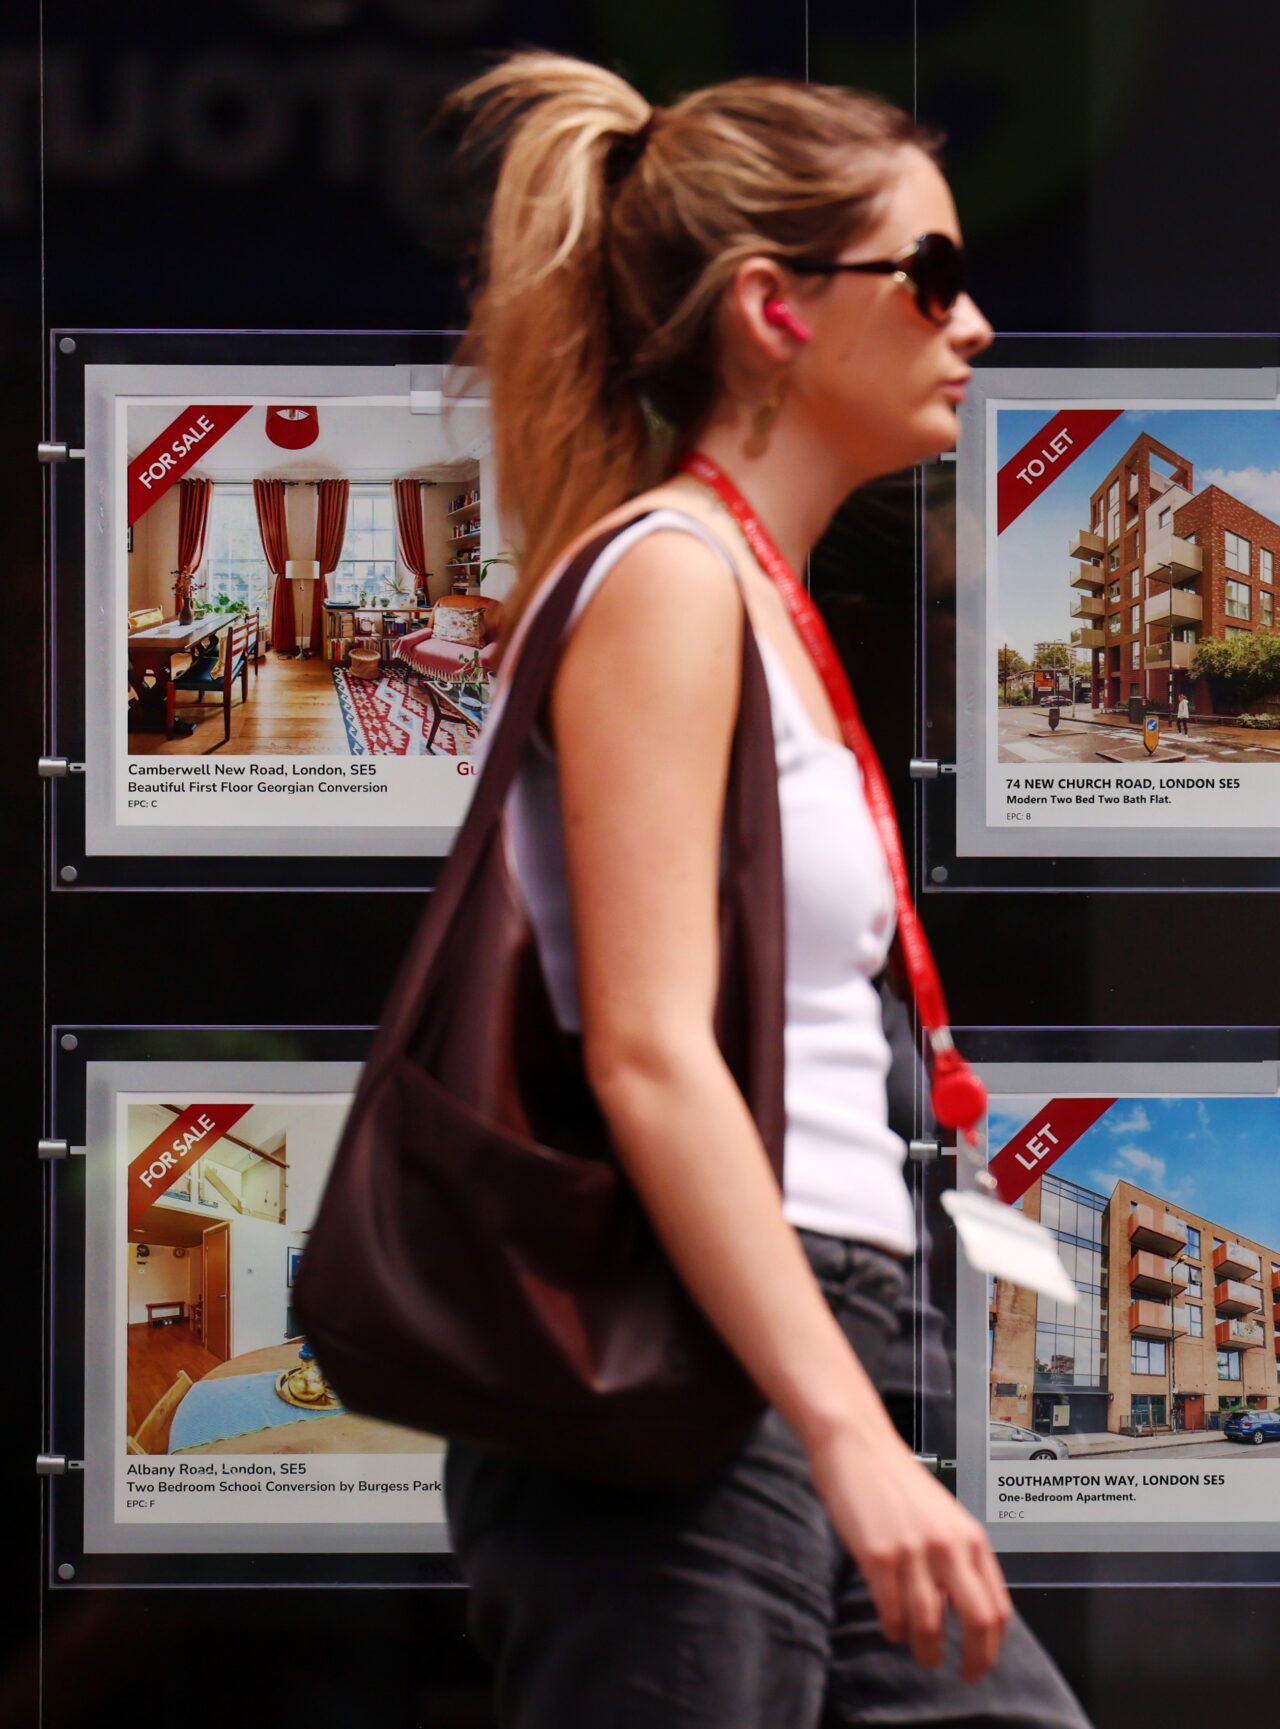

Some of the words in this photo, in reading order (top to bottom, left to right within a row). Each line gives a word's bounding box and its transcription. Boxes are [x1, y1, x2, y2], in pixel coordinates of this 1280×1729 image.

[138, 452, 178, 489] FOR
[172, 414, 216, 458] SALE
[1015, 458, 1046, 485] TO
[1041, 428, 1074, 463] LET
[128, 763, 211, 776] Camberwell
[214, 763, 246, 776] New
[249, 763, 288, 777] Road,
[292, 763, 346, 777] London,
[350, 763, 377, 776] SE5
[128, 781, 186, 793] Beautiful
[189, 781, 218, 793] First
[220, 781, 254, 793] Floor
[257, 781, 314, 795] Georgian
[317, 781, 388, 793] Conversion
[1005, 778, 1021, 790] 74
[1024, 778, 1055, 790] NEW
[1057, 778, 1112, 789] CHURCH
[1115, 778, 1155, 791] ROAD,
[1159, 778, 1215, 789] LONDON
[1218, 778, 1241, 789] SE5
[127, 799, 149, 808] EPC:
[150, 799, 158, 808] C
[1006, 794, 1048, 805] Modern
[1049, 794, 1073, 804] Two
[1075, 794, 1095, 804] Bed
[1097, 794, 1120, 804] Two
[1123, 794, 1147, 804] Bath
[1149, 794, 1172, 804] Flat.
[1006, 812, 1024, 821] EPC:
[1025, 812, 1032, 821] B
[138, 1151, 179, 1188] FOR
[172, 1113, 216, 1156] SALE
[1014, 1122, 1059, 1171] LET
[126, 1463, 176, 1478] Albany
[179, 1463, 218, 1476] Road,
[222, 1463, 276, 1476] London,
[280, 1462, 307, 1475] SE5
[126, 1481, 155, 1493] Two
[158, 1481, 216, 1493] Bedroom
[219, 1481, 262, 1492] School
[265, 1480, 336, 1492] Conversion
[339, 1480, 355, 1493] by
[358, 1480, 410, 1494] Burgess
[413, 1480, 442, 1493] Park
[997, 1475, 1101, 1487] SOUTHAMPTON
[1103, 1475, 1138, 1488] WAY,
[1142, 1474, 1200, 1486] LONDON
[1203, 1474, 1225, 1486] SE5
[126, 1499, 148, 1508] EPC:
[149, 1499, 155, 1508] F
[998, 1492, 1074, 1503] One-Bedroom
[1076, 1492, 1137, 1504] Apartment.
[998, 1510, 1017, 1519] EPC:
[1018, 1510, 1025, 1519] C
